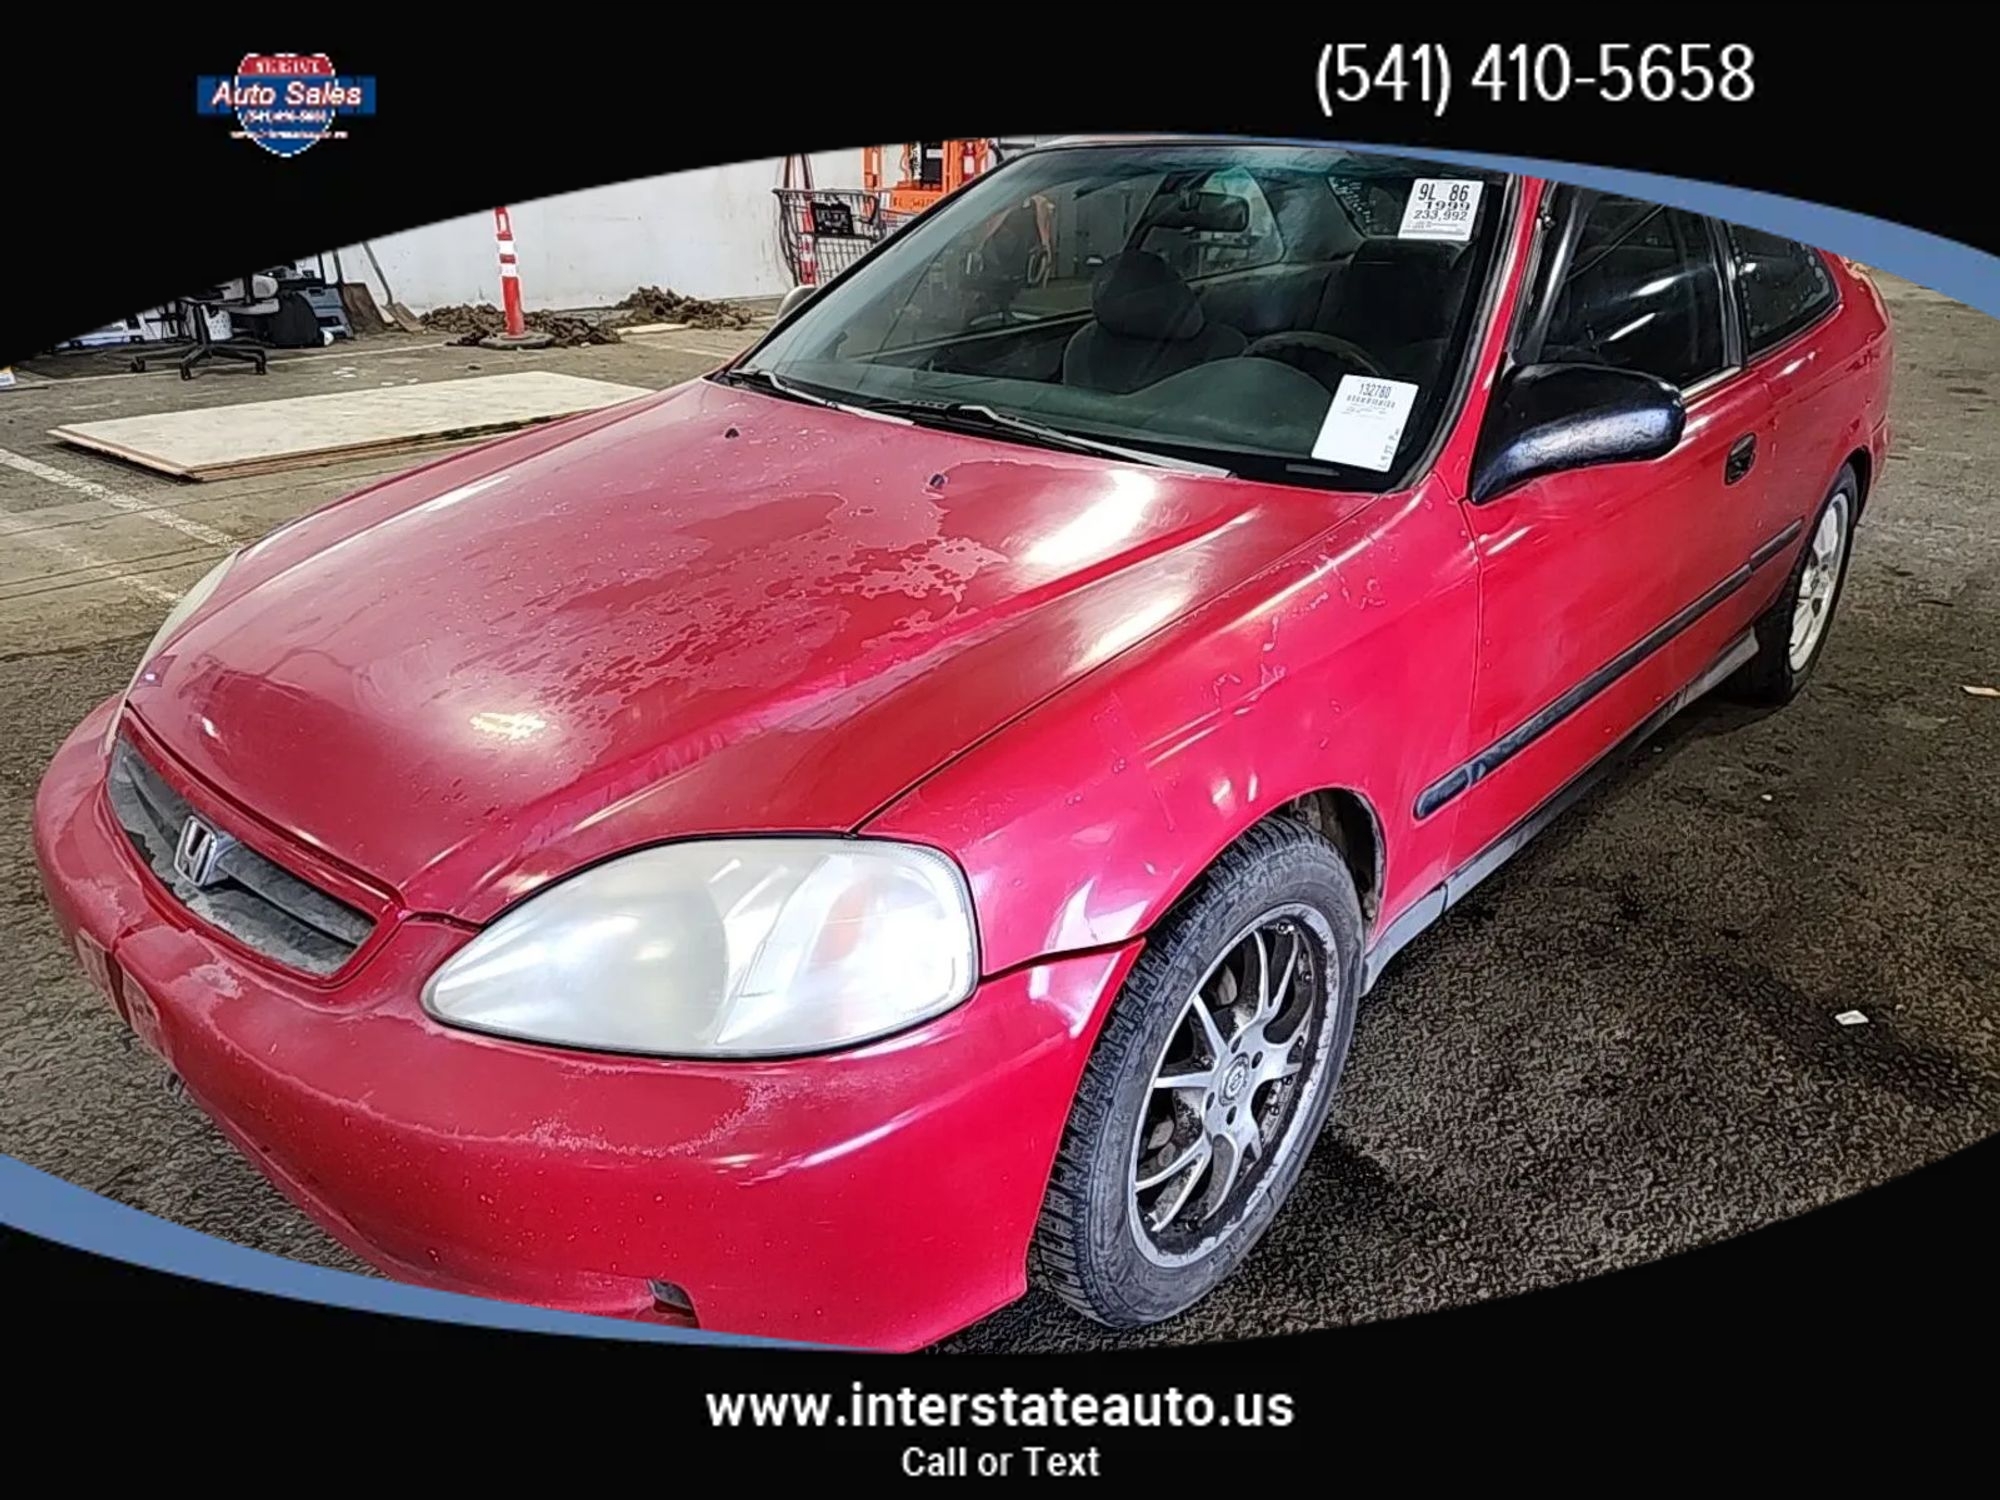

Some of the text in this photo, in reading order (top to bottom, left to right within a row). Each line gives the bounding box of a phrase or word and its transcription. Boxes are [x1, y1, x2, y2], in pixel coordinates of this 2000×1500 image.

[1418, 183, 1470, 202] 9L 86
[1413, 210, 1468, 222] 233,992
